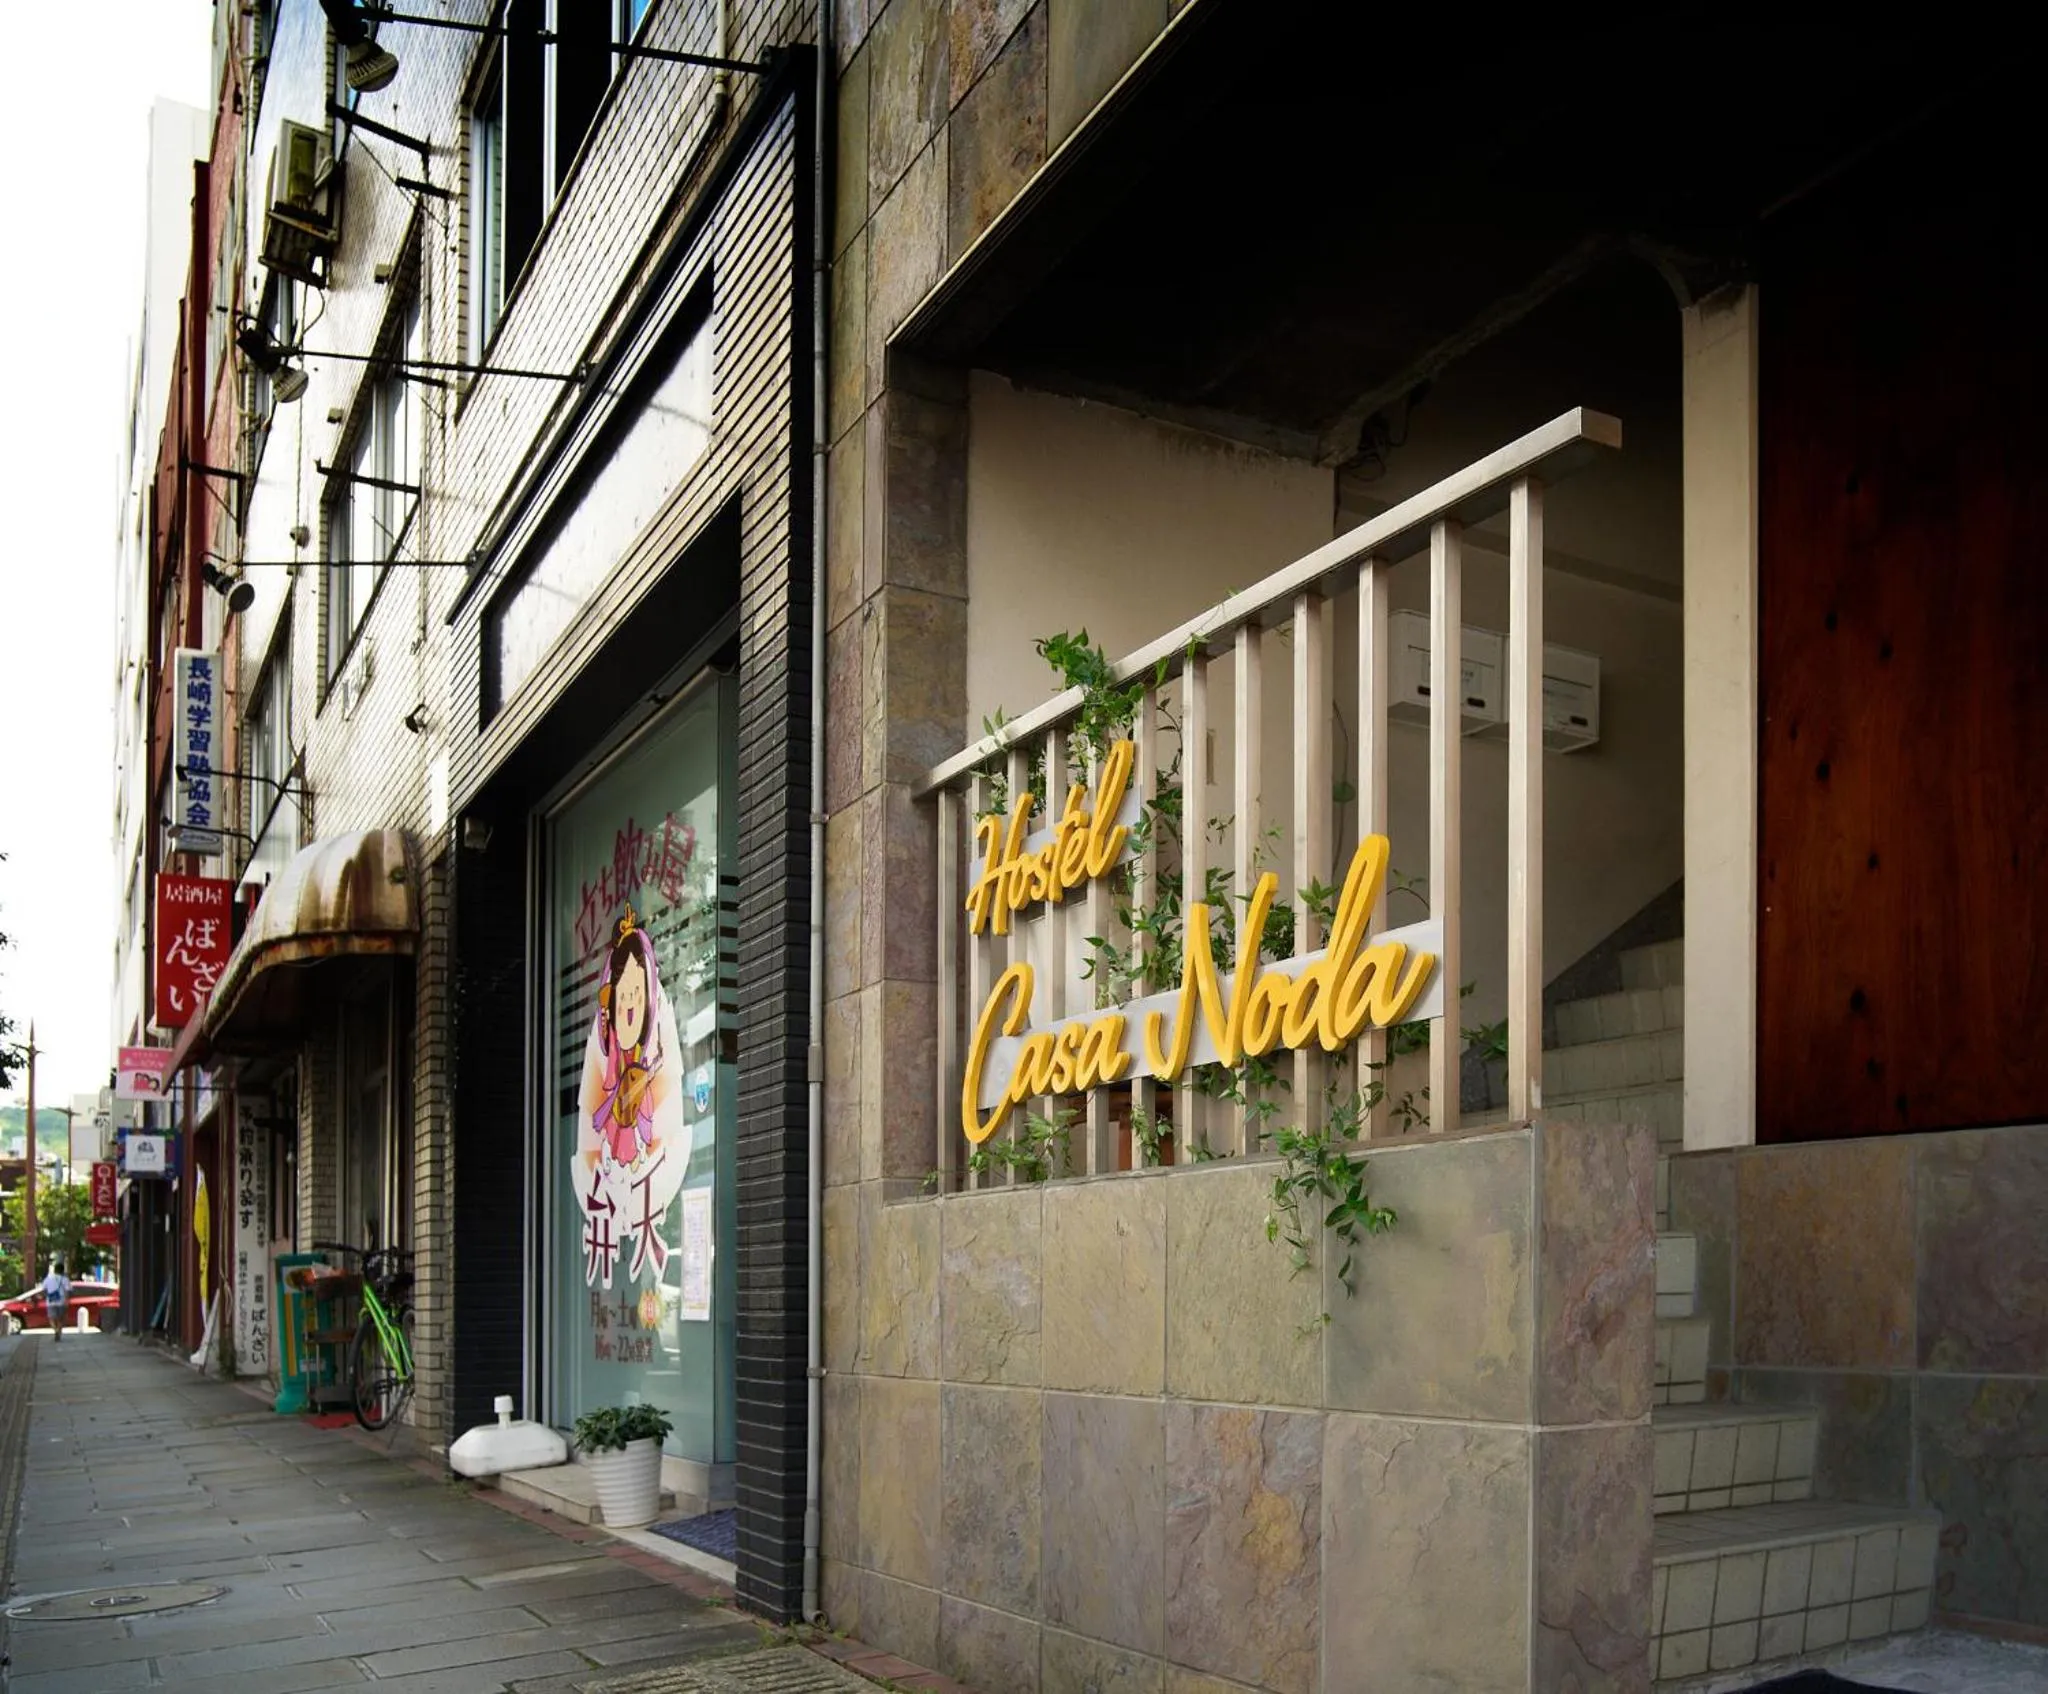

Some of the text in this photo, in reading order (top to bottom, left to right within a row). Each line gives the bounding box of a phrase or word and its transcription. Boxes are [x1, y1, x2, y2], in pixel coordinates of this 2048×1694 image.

[187, 657, 212, 826] 長崎学習塾協会
[165, 883, 223, 905] 居酒屋
[575, 811, 696, 967] 立ち飲み屋
[965, 738, 1135, 937] Hostel
[165, 917, 225, 1012] ばんざい
[962, 833, 1438, 1145] Casa Noda
[585, 1147, 668, 1281] 弁天
[252, 1309, 267, 1365] ばんざい
